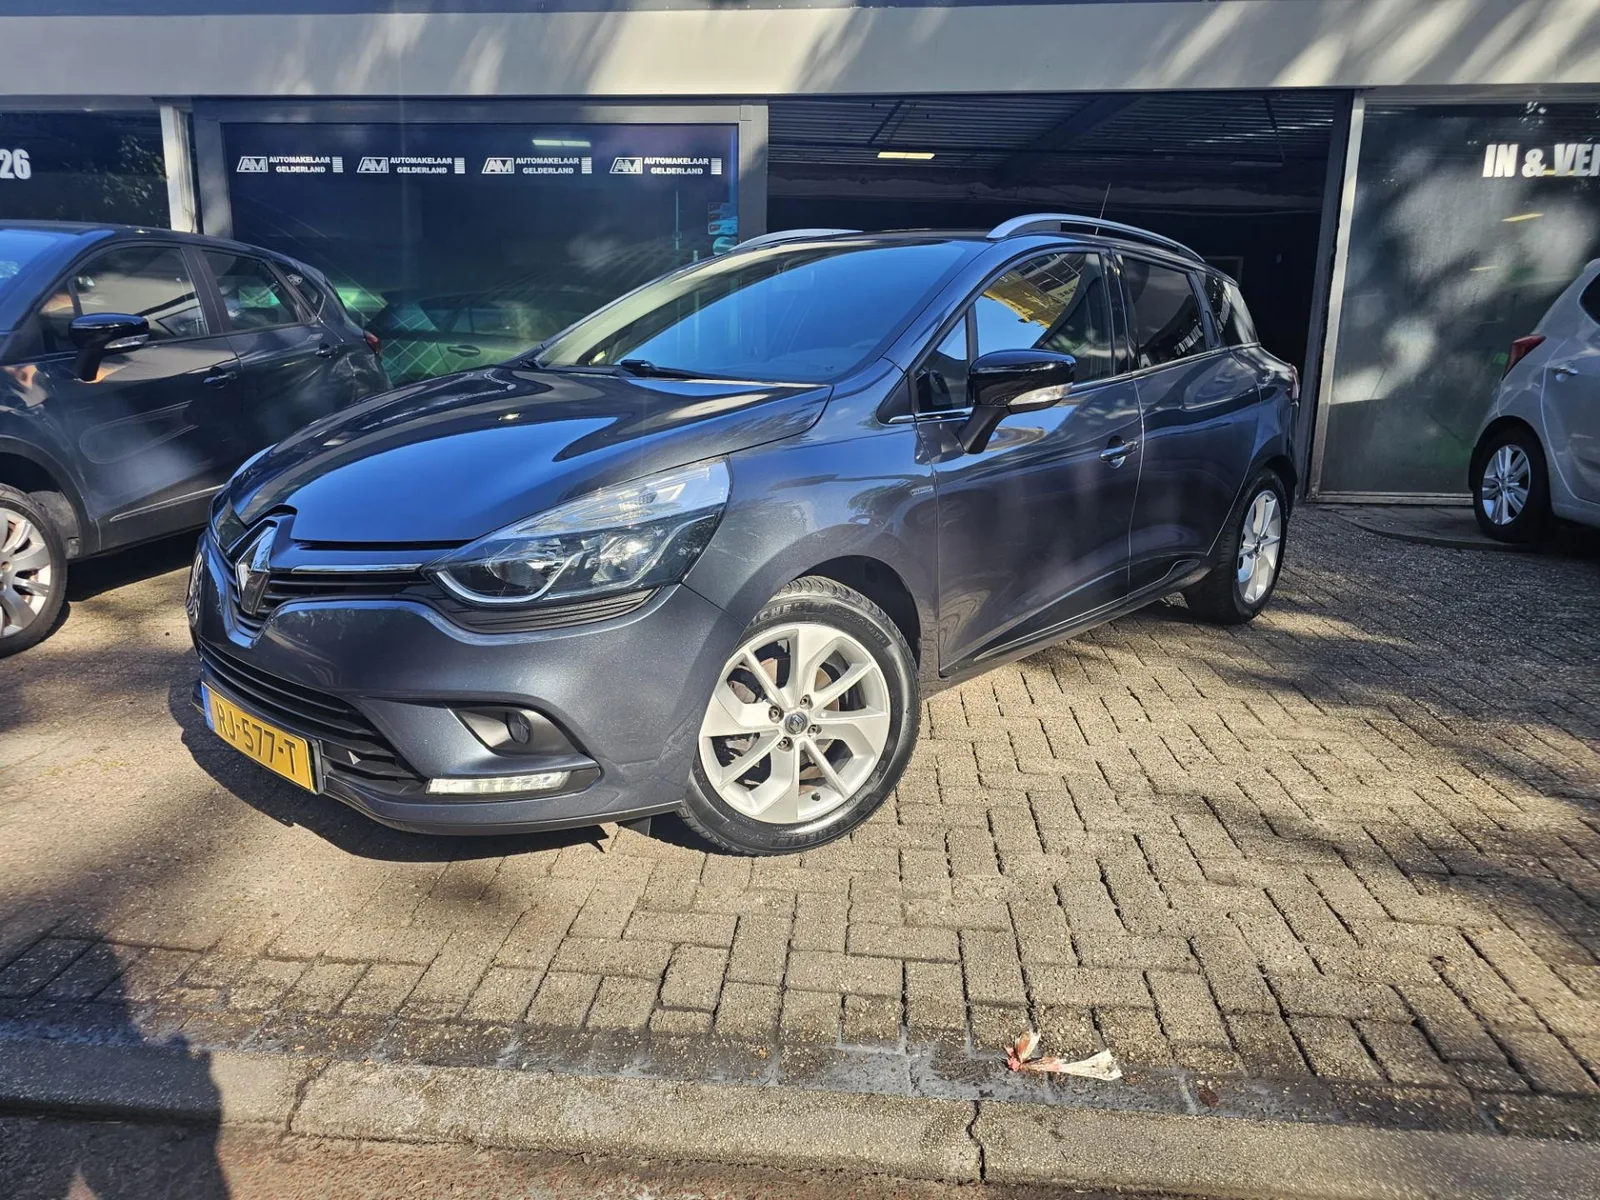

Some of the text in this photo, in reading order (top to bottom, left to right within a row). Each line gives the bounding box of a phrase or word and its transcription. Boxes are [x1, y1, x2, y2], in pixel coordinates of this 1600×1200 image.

[0, 149, 31, 179] 26
[269, 156, 331, 164] AUTOMAKELAAR
[390, 157, 453, 165] AUTOMAKELAAR
[516, 157, 580, 165] AUTOMAKELAAR
[644, 157, 709, 165] AUTOMAKELAAR
[1482, 144, 1519, 177] IN
[1521, 148, 1547, 177] &
[396, 166, 447, 174] GELDERLAND
[651, 167, 703, 175] GELDERLAND
[215, 699, 297, 775] RJ-577-T
